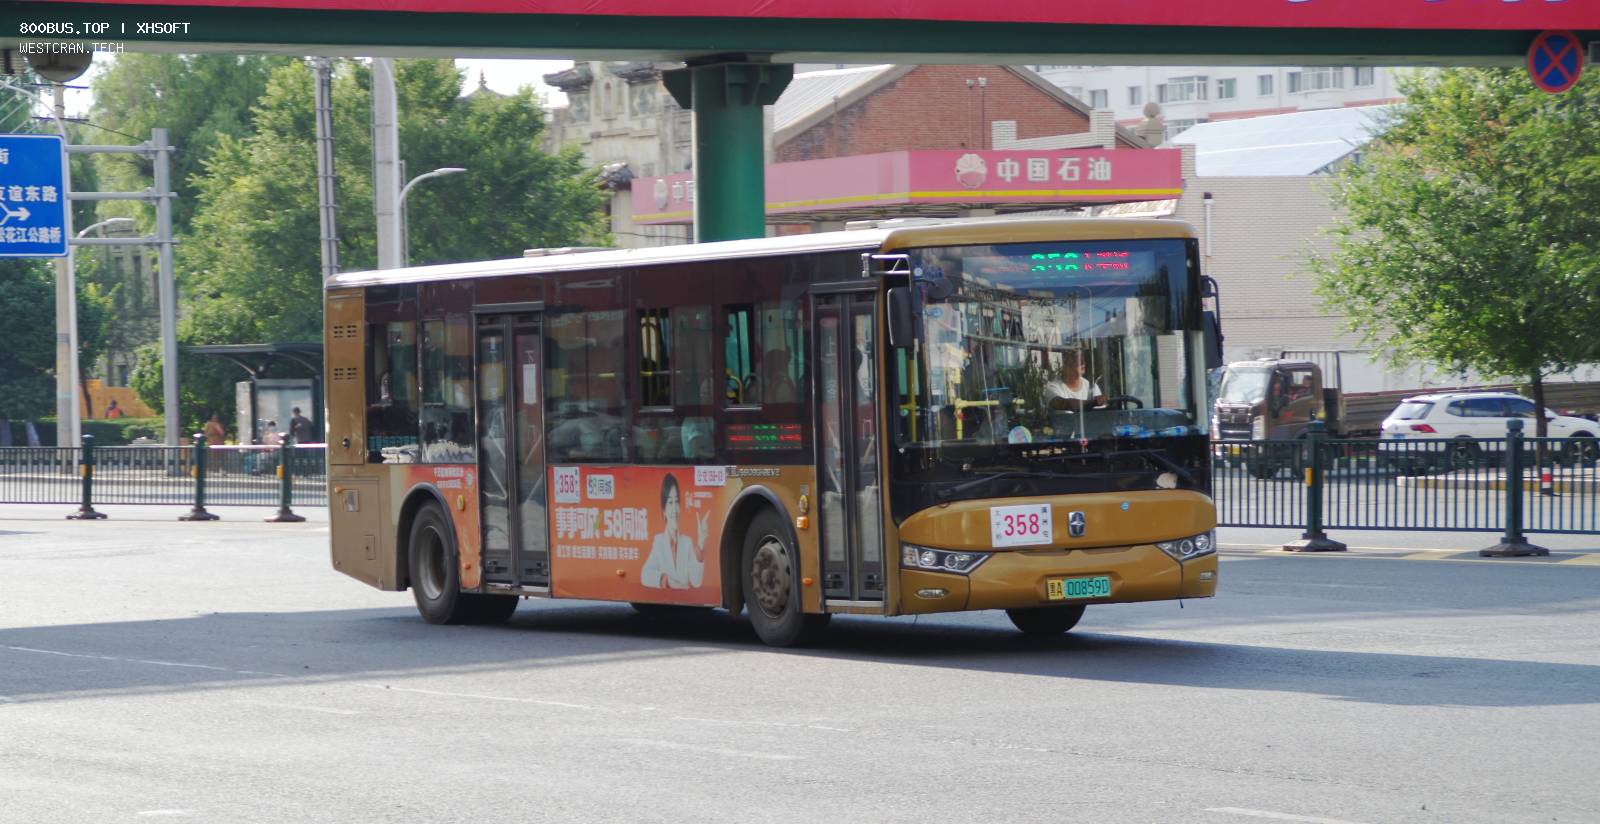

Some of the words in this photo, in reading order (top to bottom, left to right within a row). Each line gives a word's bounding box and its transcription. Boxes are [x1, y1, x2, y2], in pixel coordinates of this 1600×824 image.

[996, 157, 1112, 182] 中国石油
[559, 474, 575, 493] 358
[603, 507, 648, 540] 58同城
[1004, 513, 1040, 536] 358
